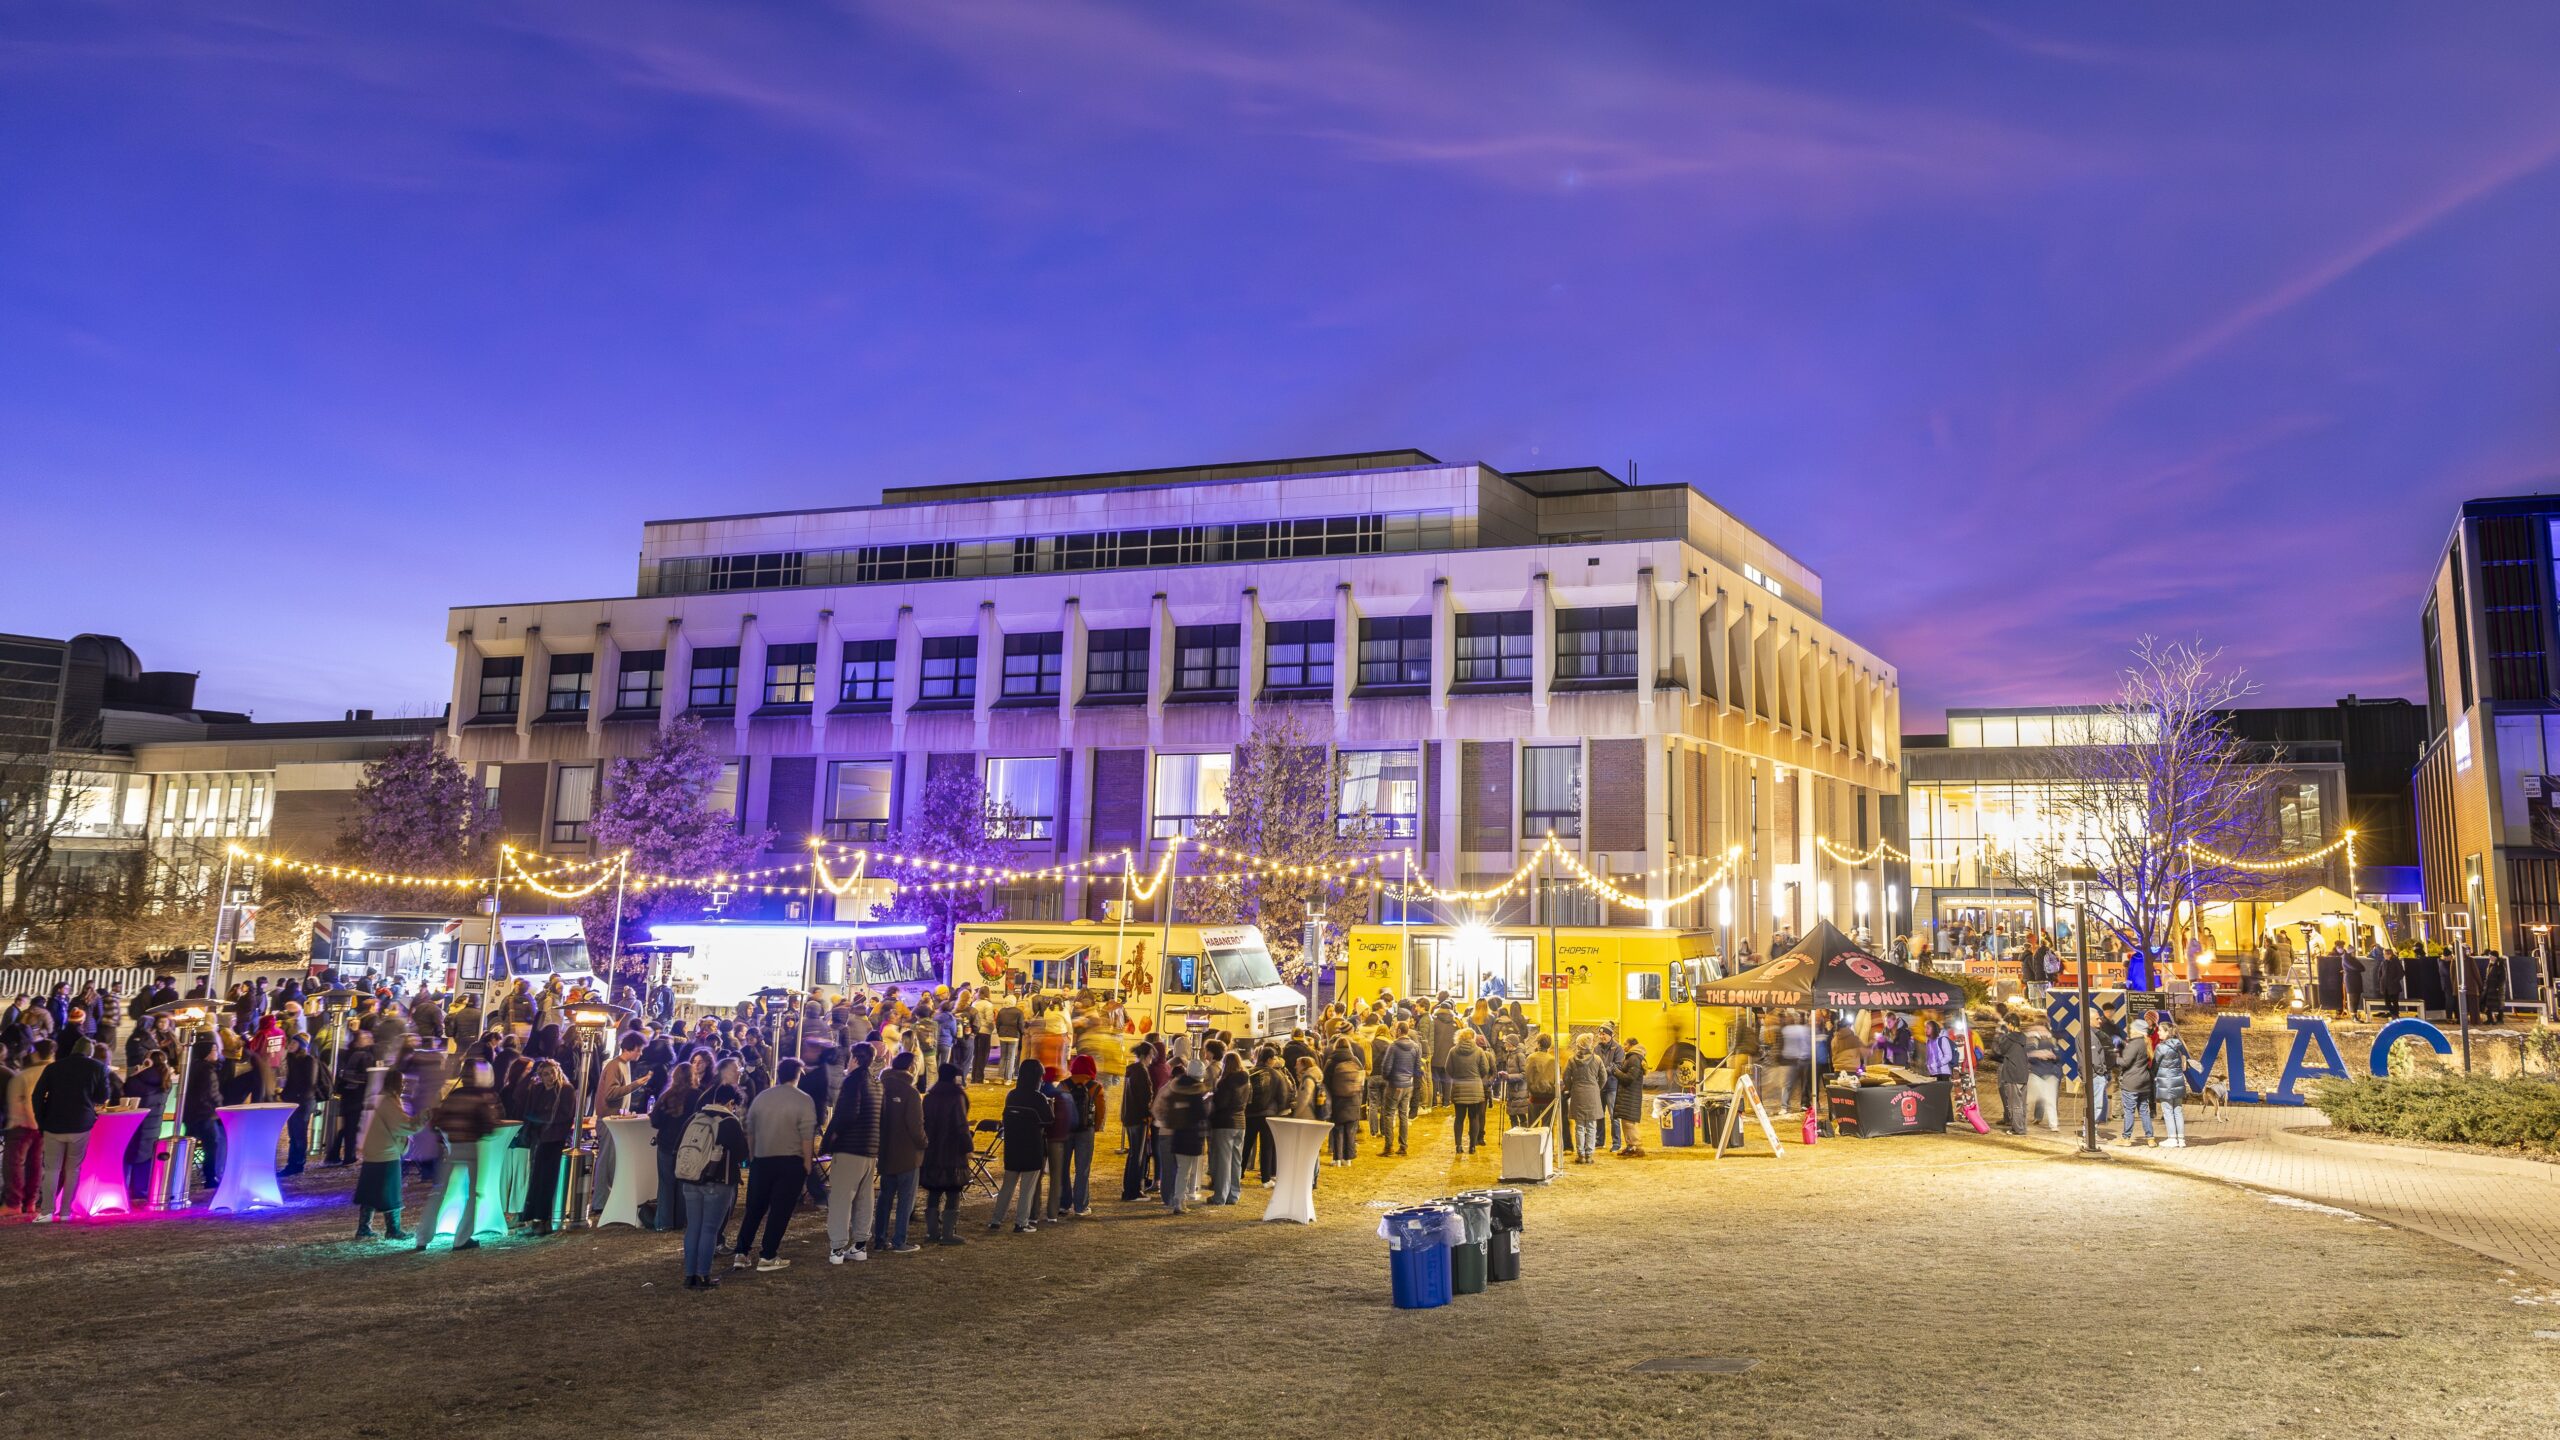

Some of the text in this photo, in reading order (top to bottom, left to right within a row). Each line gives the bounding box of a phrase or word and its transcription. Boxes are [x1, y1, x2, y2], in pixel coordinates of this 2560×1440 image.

[977, 937, 1010, 951] HABANERO
[1204, 935, 1241, 947] HABANERO
[1706, 990, 1800, 1005] THE DONUT TRAP
[1828, 991, 1949, 1006] THE DONUT TRAP
[2138, 1010, 2453, 1106] MAC
[1890, 1090, 1925, 1105] THE DONUT
